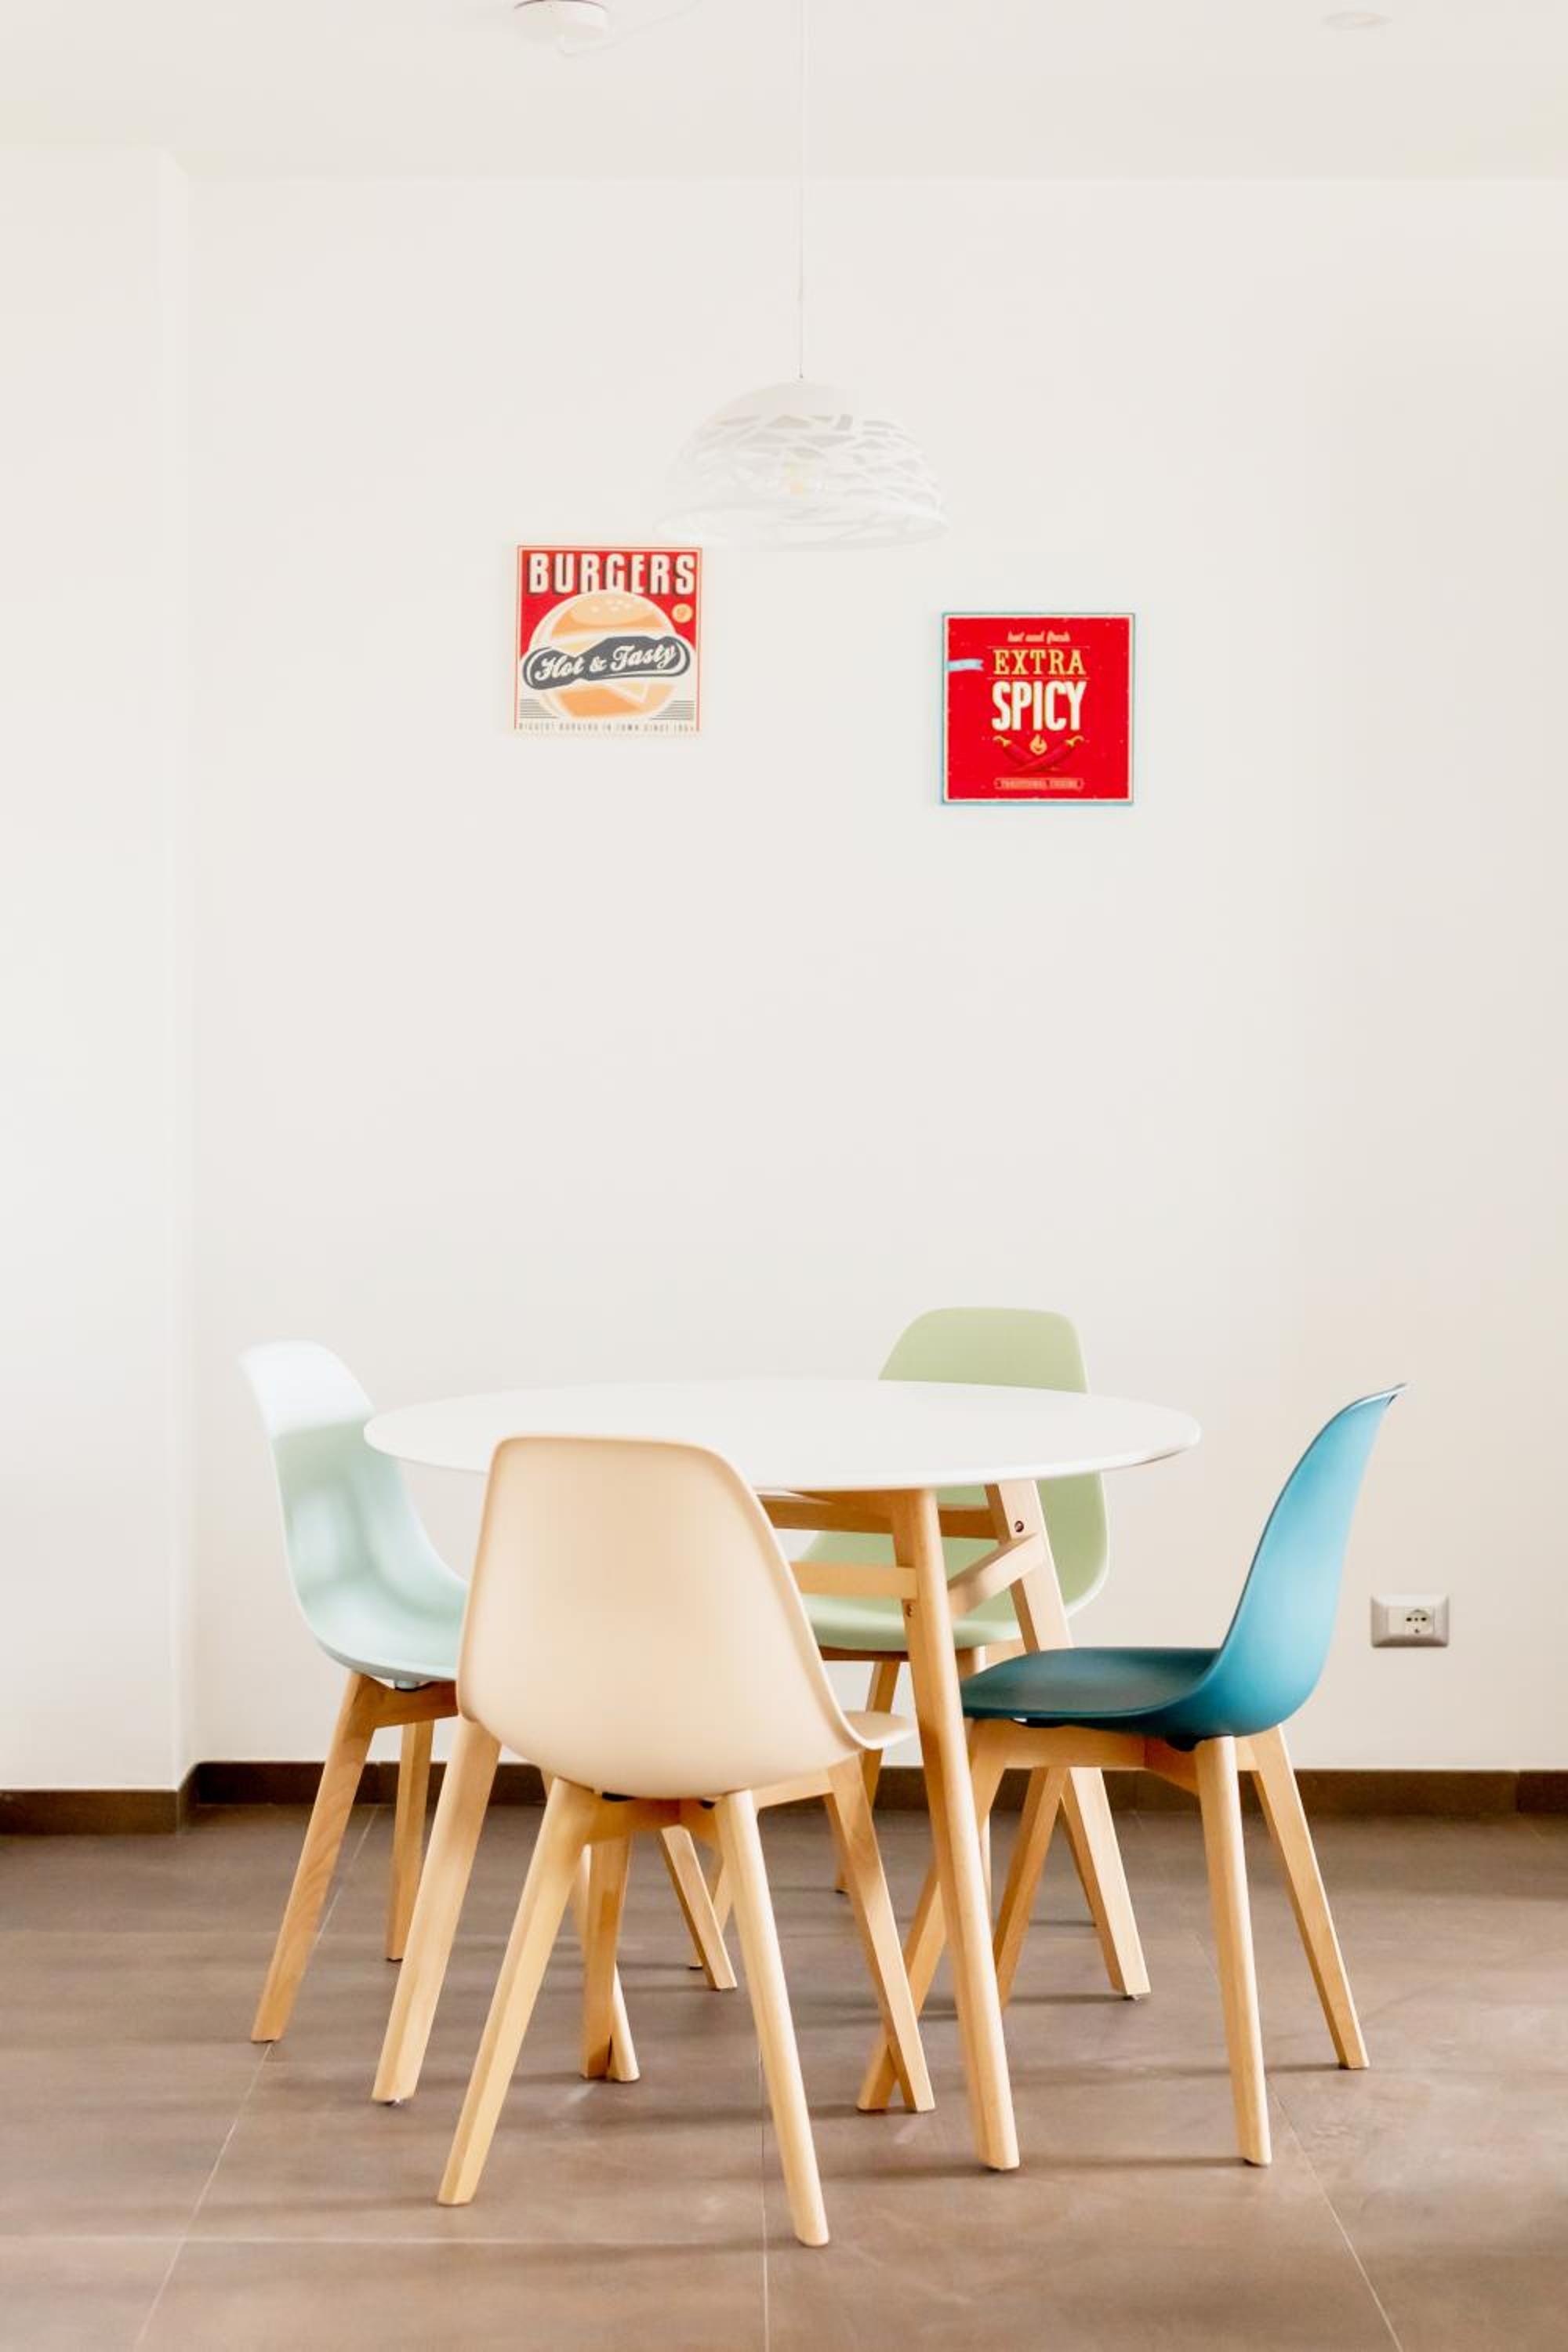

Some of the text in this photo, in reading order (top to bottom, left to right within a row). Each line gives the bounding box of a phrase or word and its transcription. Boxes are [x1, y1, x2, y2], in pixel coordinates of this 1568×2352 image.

[528, 552, 695, 595] BURGERS
[534, 644, 677, 681] Hot & Tasty
[993, 648, 1087, 676] EXTRA
[991, 680, 1087, 731] SPICY
